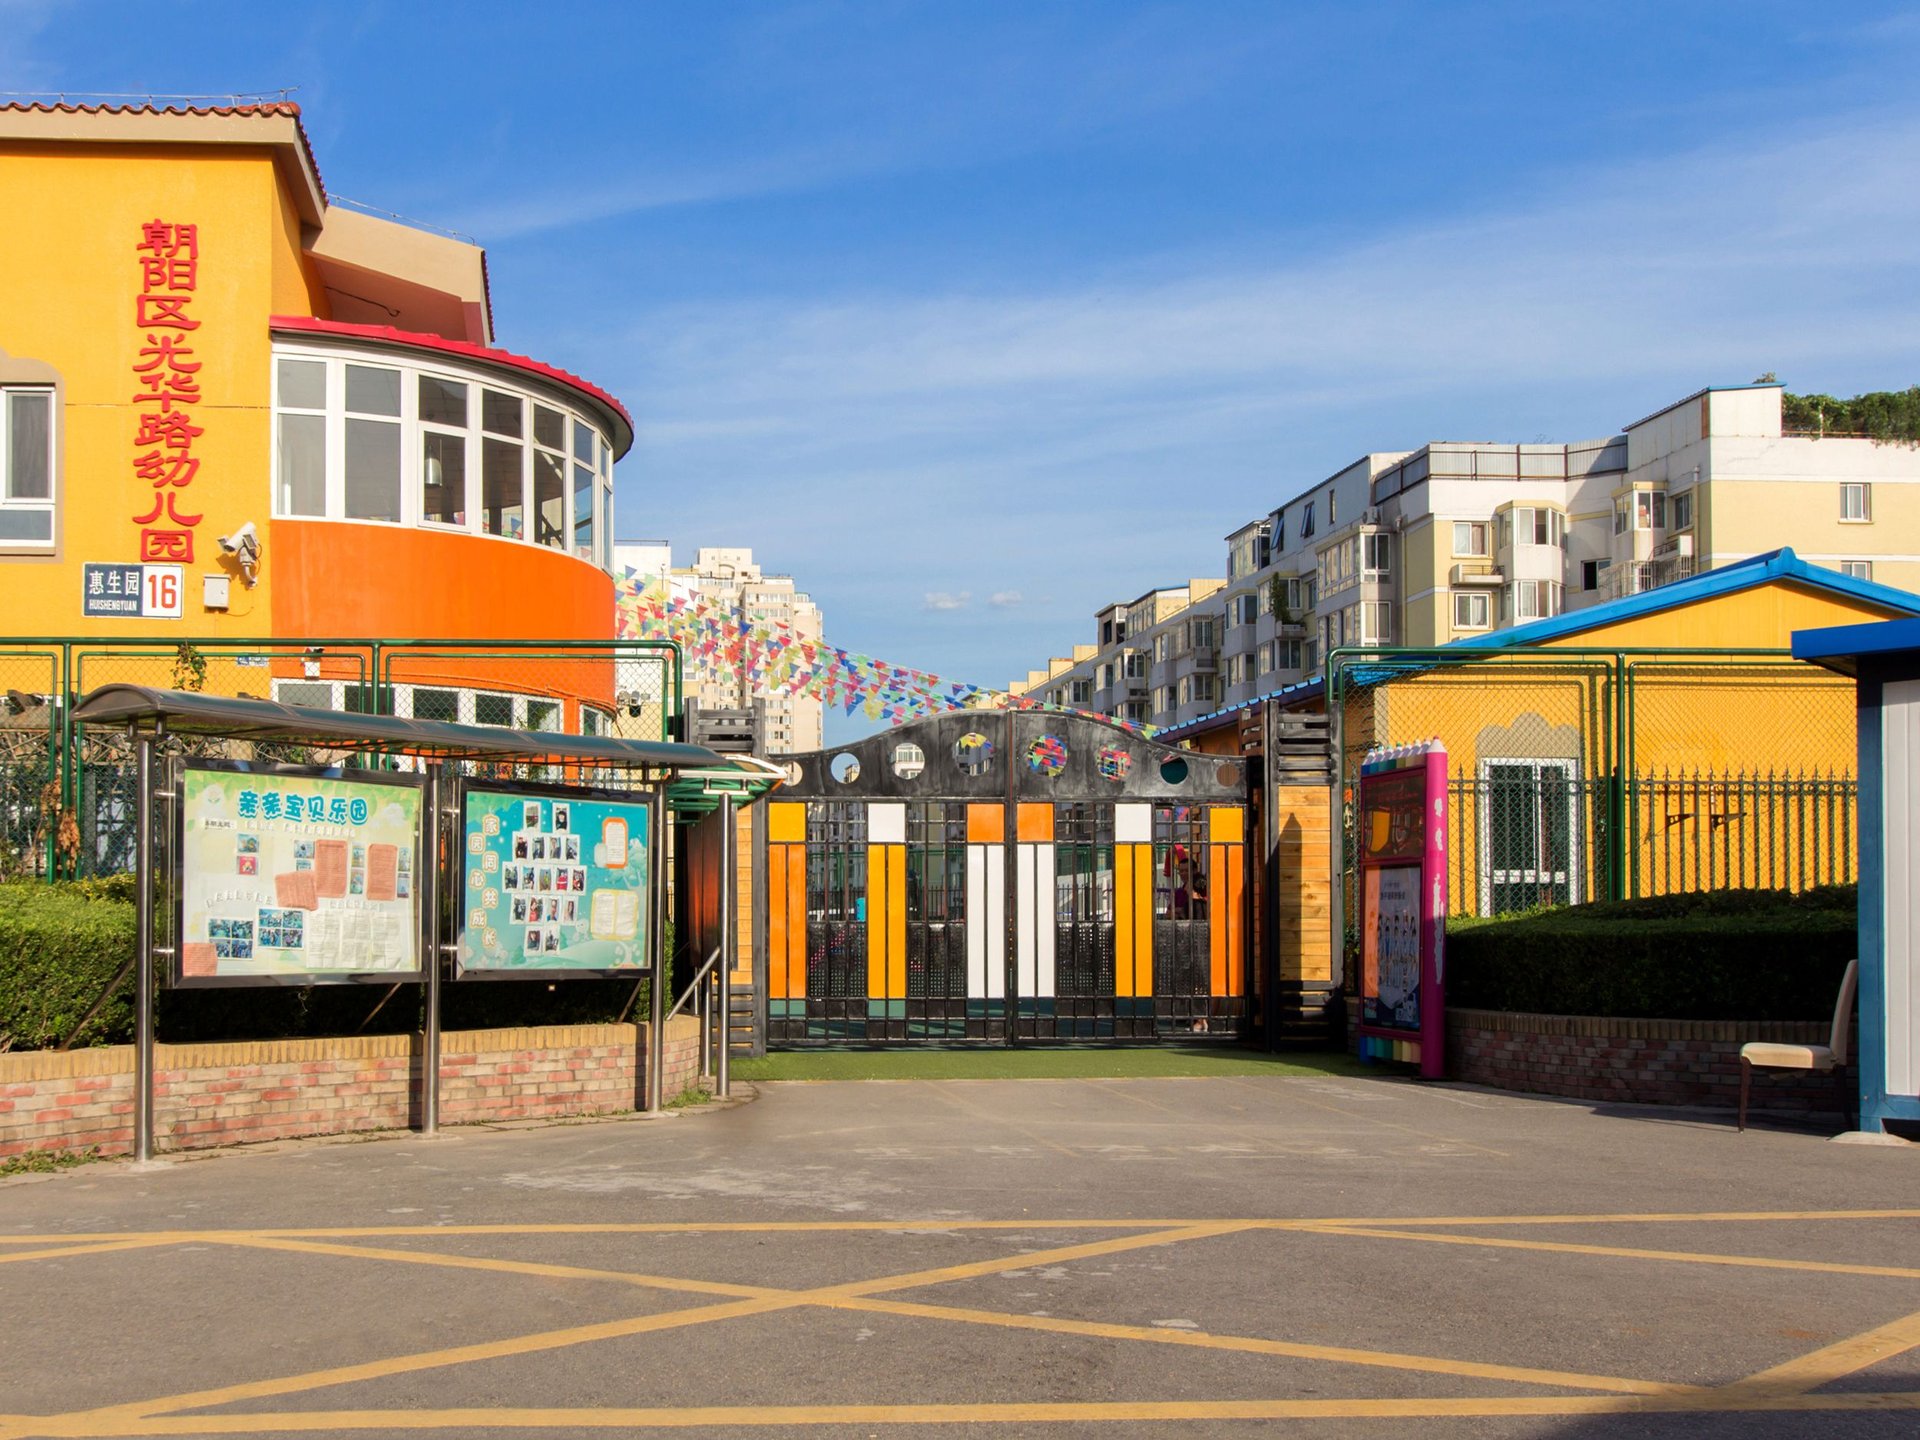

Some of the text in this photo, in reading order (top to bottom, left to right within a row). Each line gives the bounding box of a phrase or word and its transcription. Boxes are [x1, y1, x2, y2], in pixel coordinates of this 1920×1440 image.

[132, 218, 204, 563] 朝阳区光华路幼儿园
[89, 570, 140, 596] 惠生园
[148, 574, 177, 609] 16
[88, 599, 138, 612] HUISHENGYUAN
[238, 790, 368, 825] 亲亲宝贝乐园
